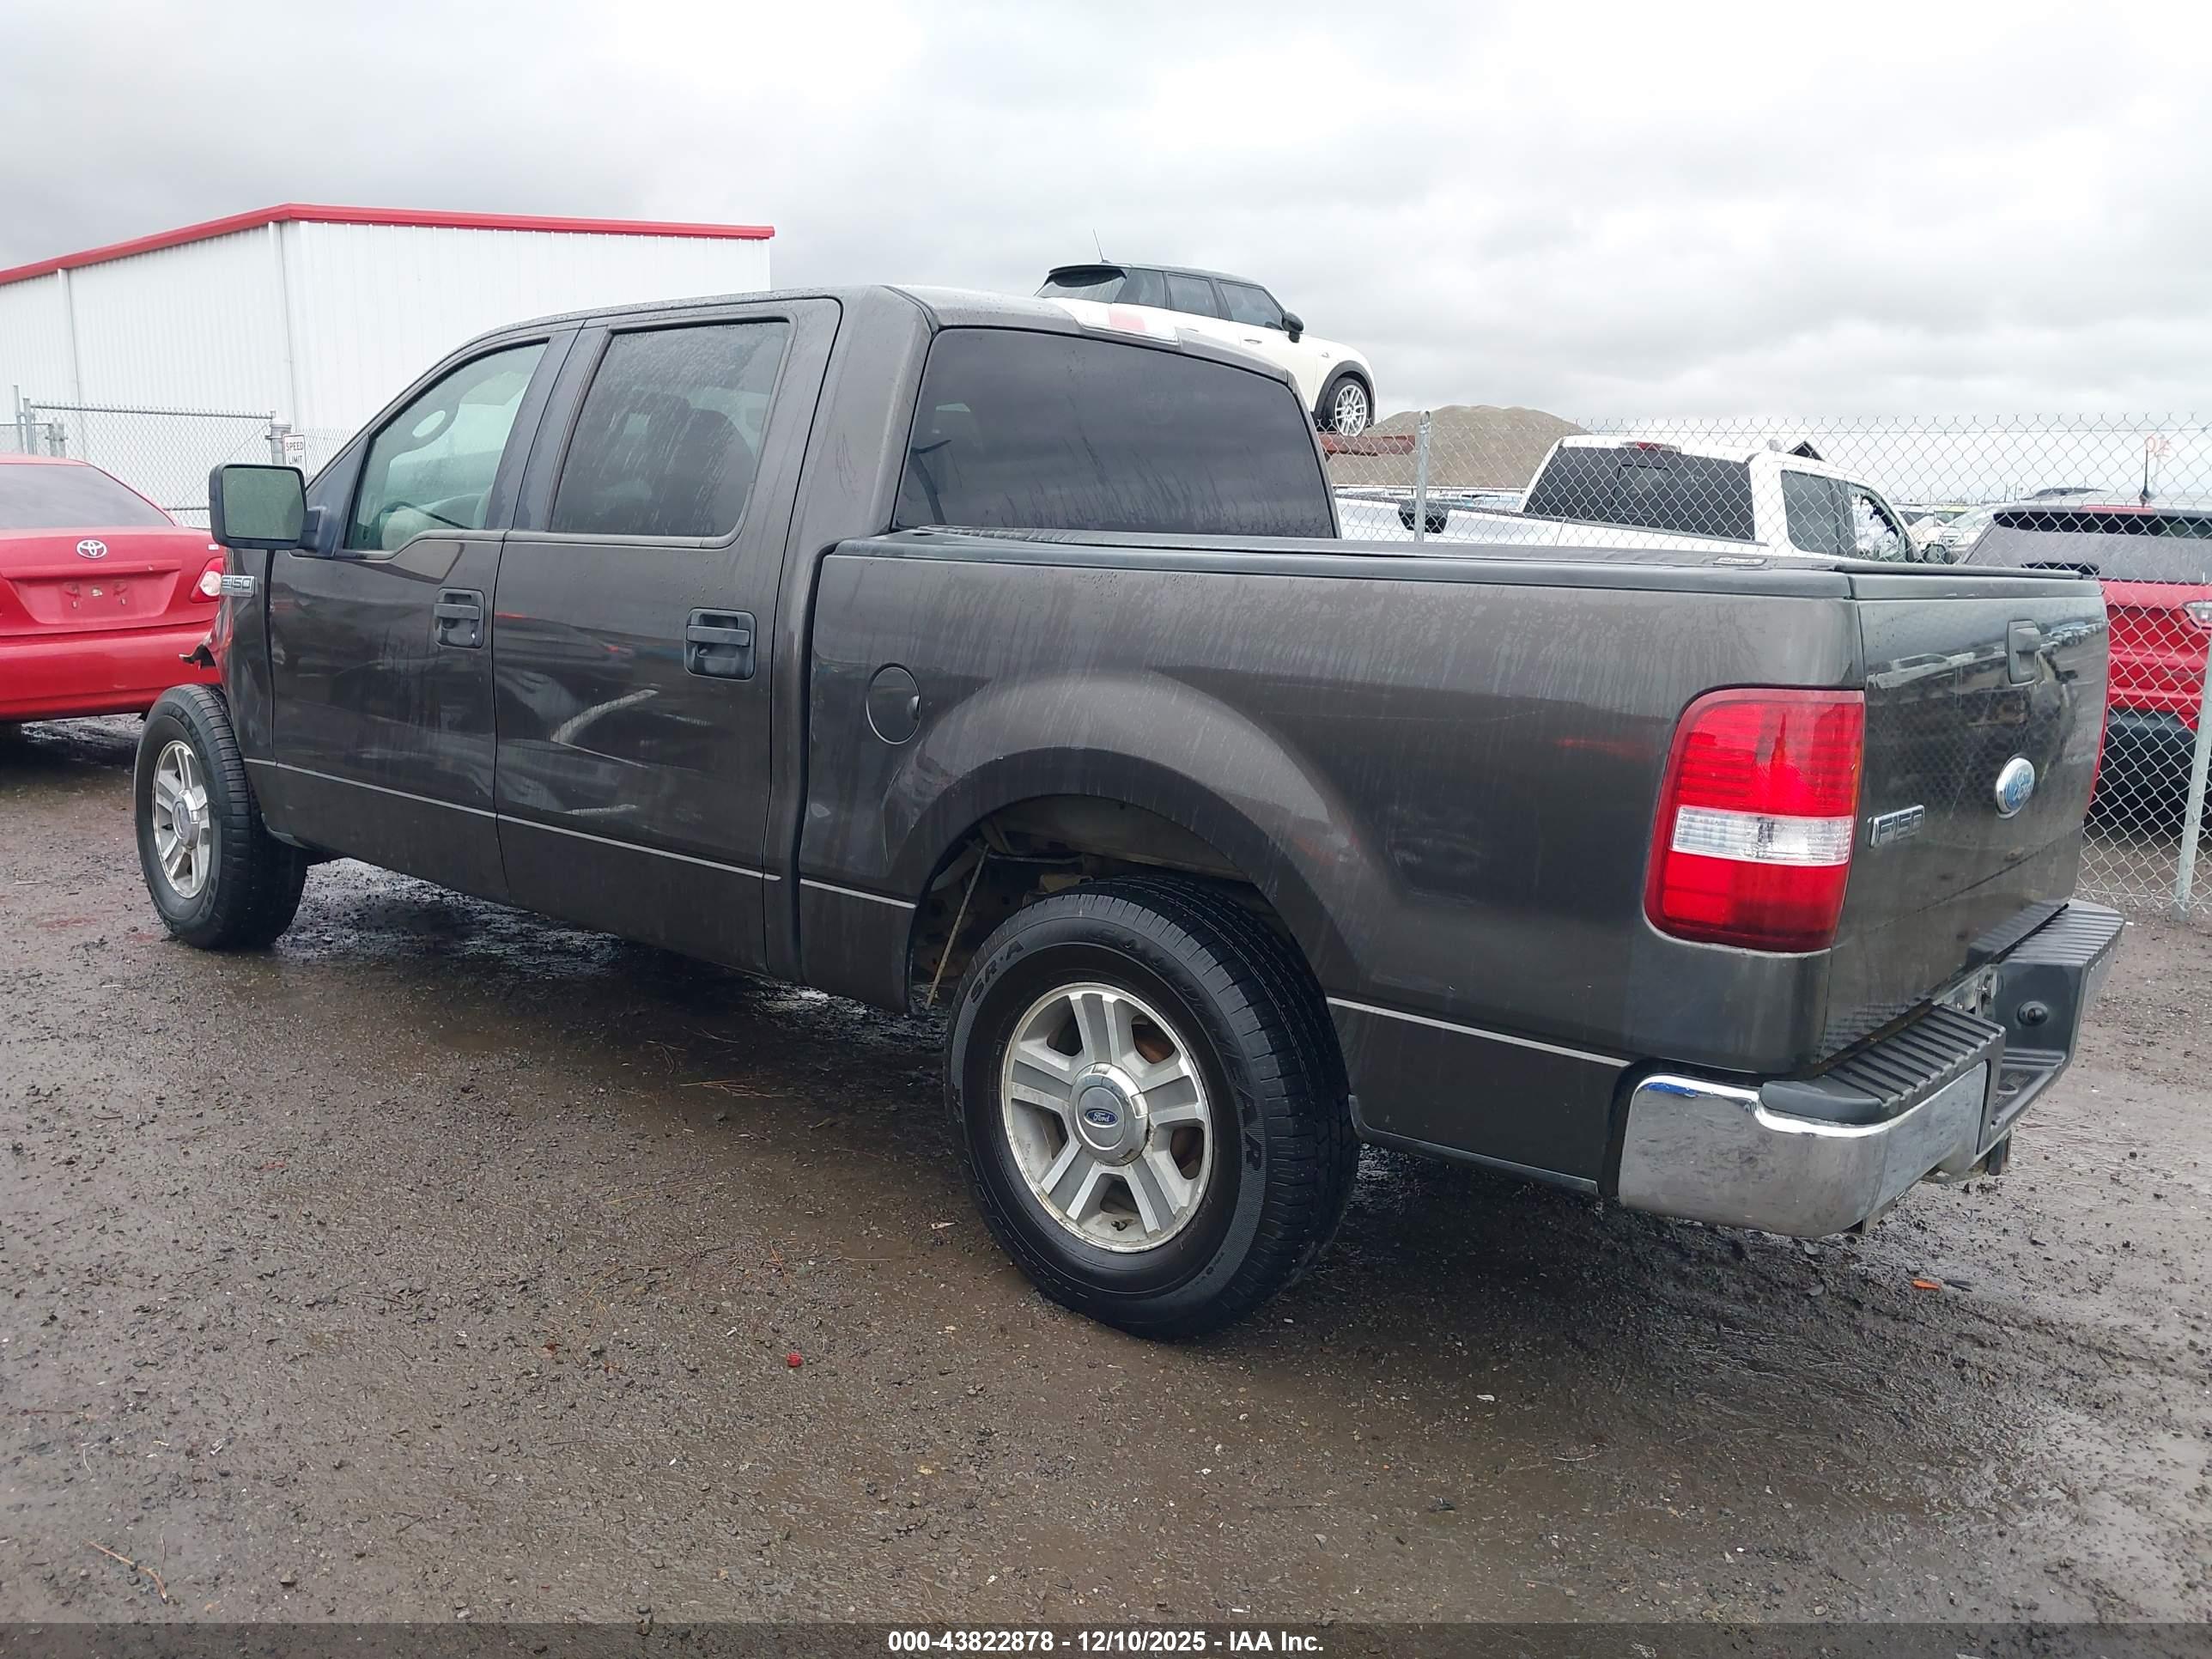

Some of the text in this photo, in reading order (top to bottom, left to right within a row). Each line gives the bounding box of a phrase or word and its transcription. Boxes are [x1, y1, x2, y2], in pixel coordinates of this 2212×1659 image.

[285, 441, 304, 453] SPEED
[289, 454, 303, 465] LIMIT
[1871, 805, 1924, 845] F150
